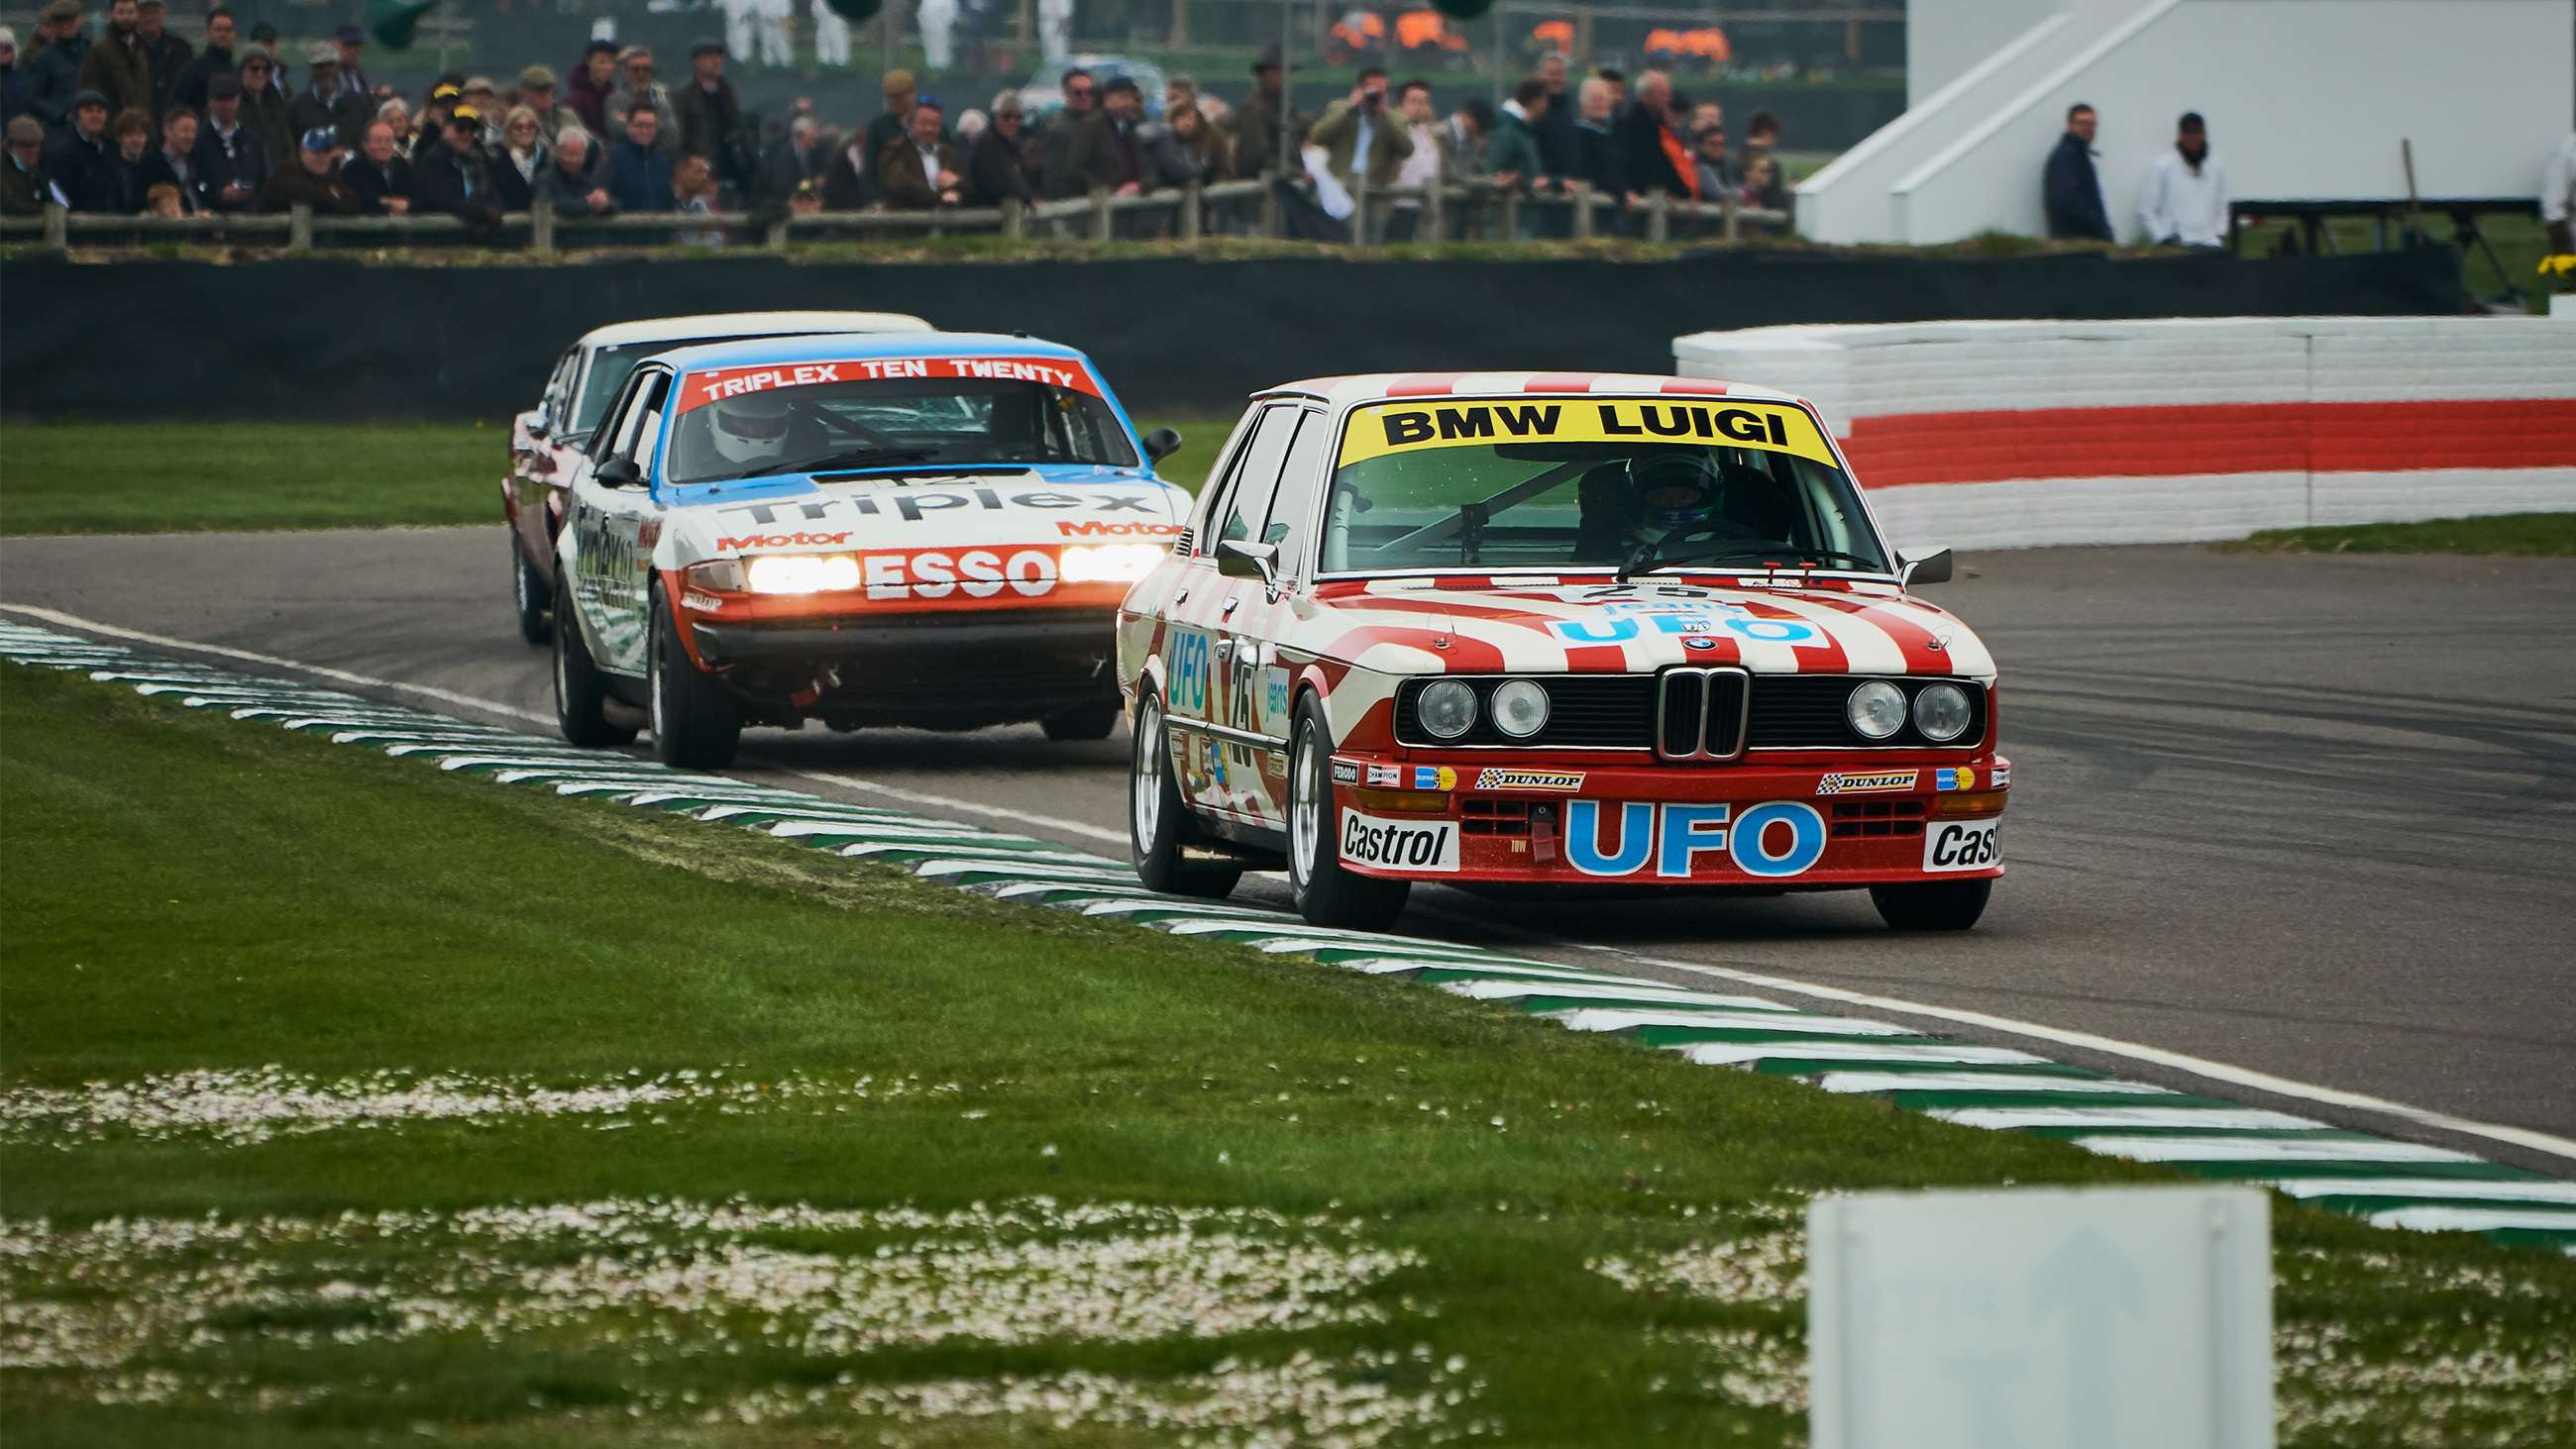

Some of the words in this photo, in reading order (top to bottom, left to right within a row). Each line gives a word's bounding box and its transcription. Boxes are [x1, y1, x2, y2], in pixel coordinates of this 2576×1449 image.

[701, 364, 839, 401] TRIPLEX
[861, 360, 928, 379] TEN
[949, 359, 1074, 388] TWENTY
[1381, 405, 1562, 447] BMW
[1597, 405, 1789, 447] LUIGI
[715, 489, 1162, 525] Triplex
[716, 531, 854, 552] Motor
[864, 550, 1057, 600] ESSO
[1582, 585, 1709, 598] 25
[1602, 602, 1747, 616] jeans
[1557, 614, 1813, 642] UFO
[1169, 631, 1207, 710] UFO
[1503, 774, 1581, 786] DUNLOP
[1841, 776, 1914, 787] DUNLOP
[1344, 814, 1449, 866] Castrol
[1511, 839, 1527, 853] TOW
[1564, 798, 1827, 878] UFO
